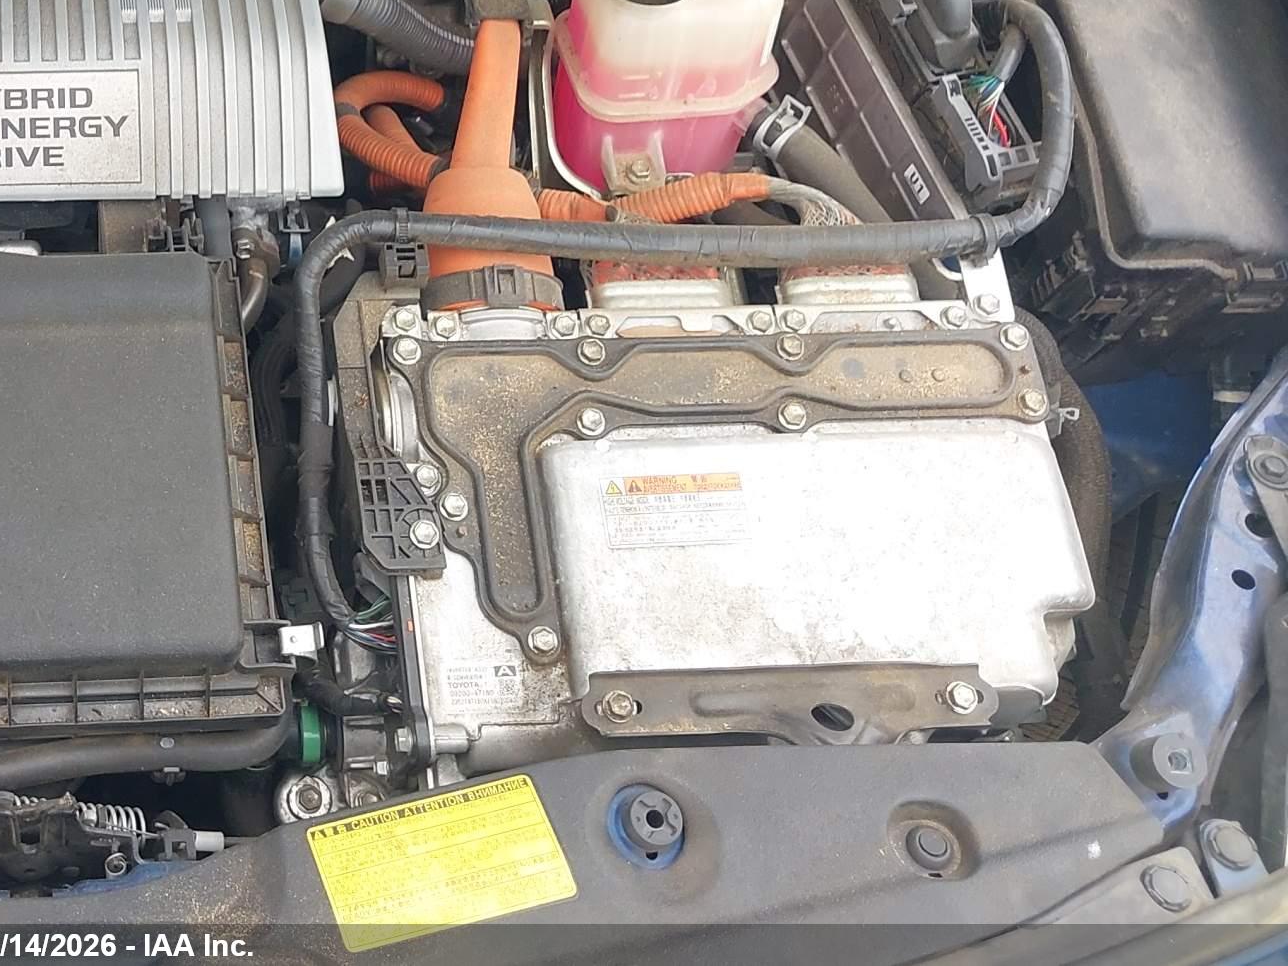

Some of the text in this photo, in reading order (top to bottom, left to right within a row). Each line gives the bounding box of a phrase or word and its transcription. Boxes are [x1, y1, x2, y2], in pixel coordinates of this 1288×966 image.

[448, 681, 480, 689] TOYOTA
[351, 810, 400, 830] CAUTION
[404, 795, 465, 818] ATTENTION
[468, 777, 528, 801] ВНИМАНИЕ
